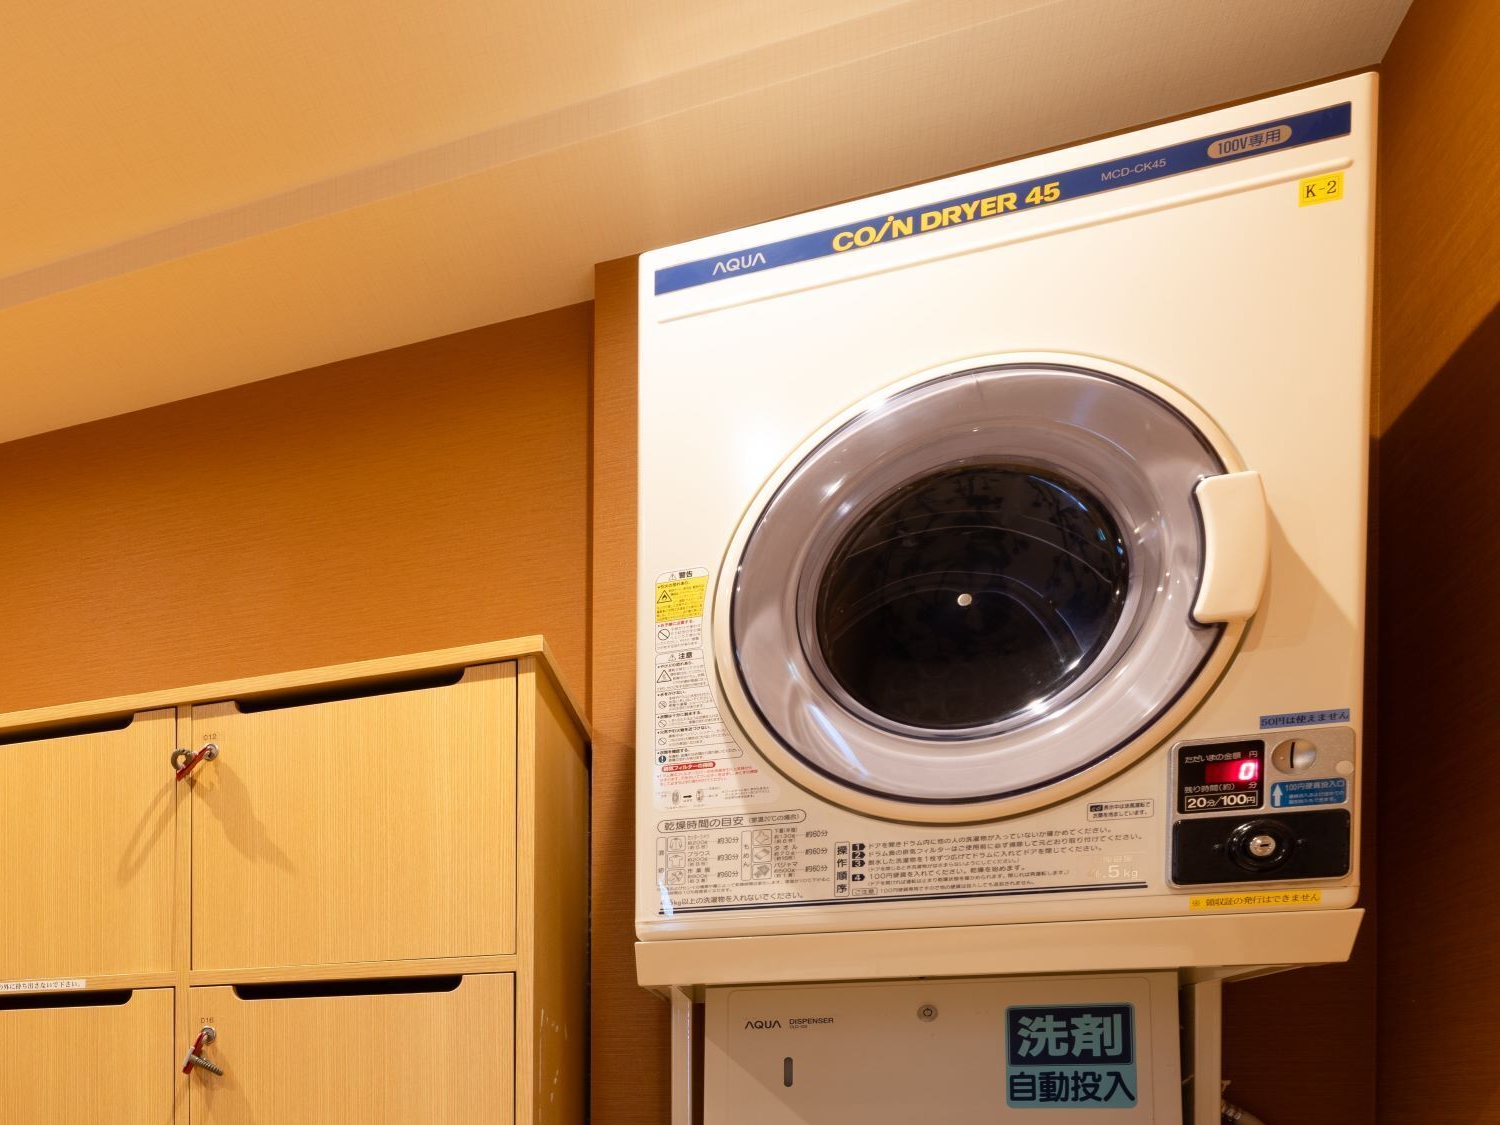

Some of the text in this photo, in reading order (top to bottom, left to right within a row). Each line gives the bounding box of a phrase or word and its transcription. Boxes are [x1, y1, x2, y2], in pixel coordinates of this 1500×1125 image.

[1217, 128, 1281, 155] 100V専用
[1101, 158, 1167, 182] MCD-CK45
[1305, 180, 1337, 199] K-2
[832, 181, 1061, 253] COIN DRYER 45
[712, 252, 766, 276] AQUA
[1261, 712, 1349, 728] 50円は使えません
[1185, 750, 1258, 764] ただいまの金額 円
[1239, 762, 1256, 780] 0
[1187, 794, 1256, 809] 20分/100円
[664, 816, 744, 831] 乾燥時間の目安
[836, 846, 848, 893] 操作順序
[745, 1020, 782, 1030] AQUA
[789, 1017, 834, 1025] DISPENSER
[1017, 1014, 1122, 1058] 洗剤
[1009, 1072, 1135, 1103] 自動投入
